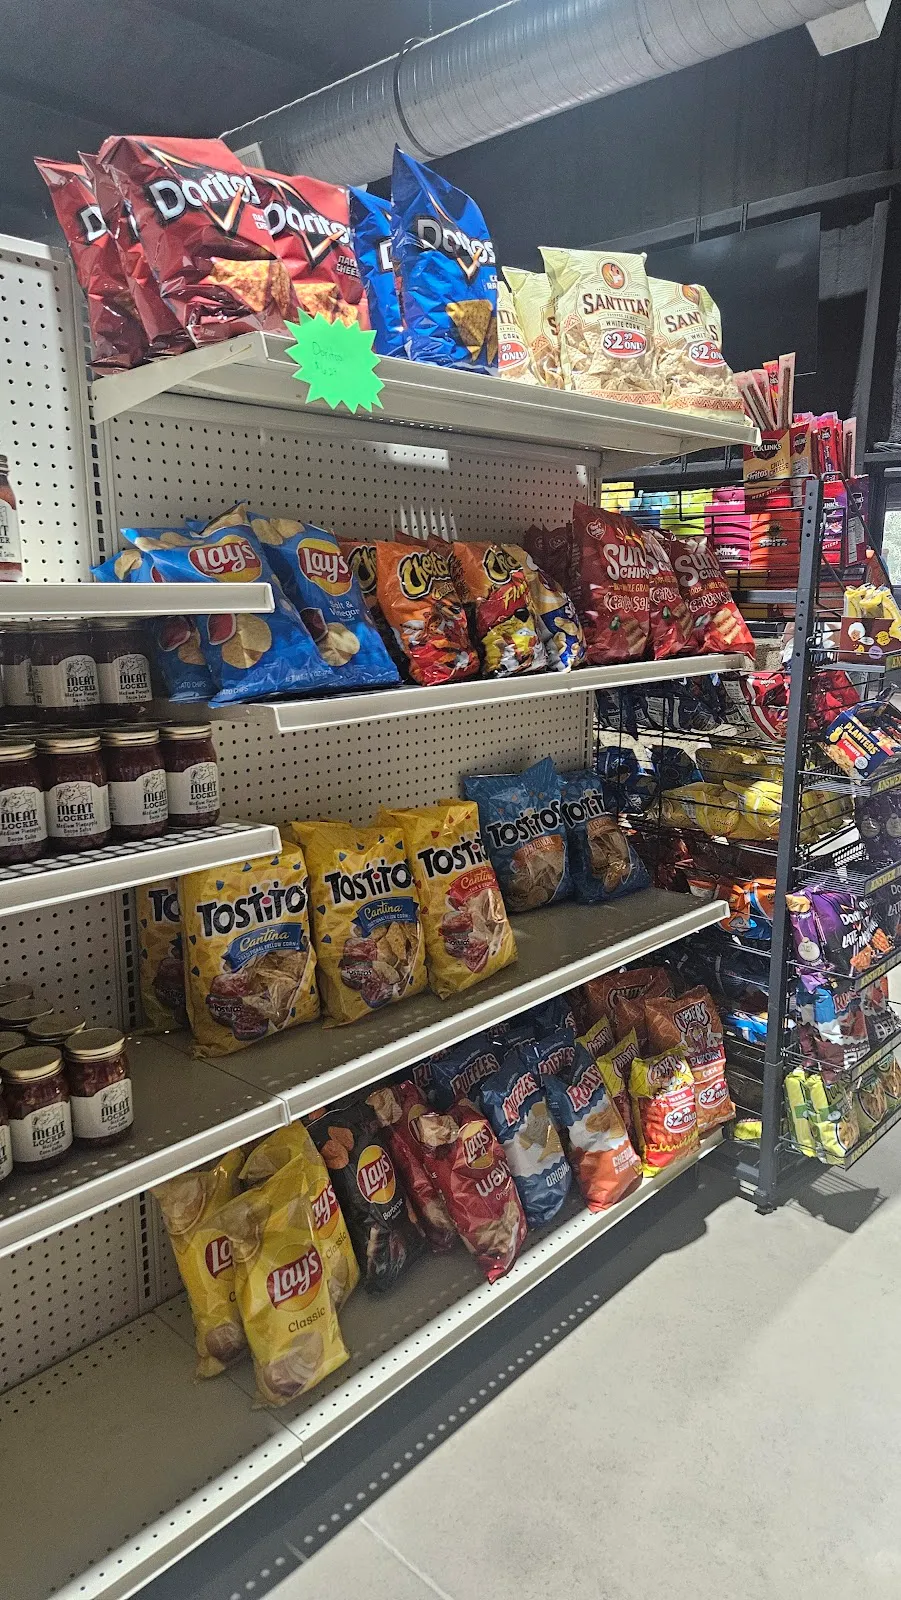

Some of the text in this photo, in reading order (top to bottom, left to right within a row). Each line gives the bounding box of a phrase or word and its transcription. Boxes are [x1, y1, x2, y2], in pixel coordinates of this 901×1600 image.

[606, 321, 640, 331] WHITE CORN
[603, 334, 623, 350] $2
[747, 470, 768, 480] Fritos
[195, 540, 256, 573] Lay's
[302, 547, 349, 583] Lay's
[619, 565, 650, 579] CHIPS
[329, 607, 360, 621] Vinegar
[67, 675, 95, 686] MEAT
[120, 672, 147, 684] MEAT
[843, 721, 879, 755] PLANTERS
[144, 789, 167, 803] MEAT
[191, 780, 217, 794] MEAT
[1, 809, 37, 823] MEAT
[57, 802, 93, 816] MEAT
[57, 813, 95, 823] LOCKER
[2, 819, 39, 831] LOCKER
[486, 799, 564, 848] TOSTITOS
[364, 900, 403, 920] Cantina
[239, 927, 290, 952] Cantina
[101, 1097, 130, 1117] MEAT
[33, 1120, 65, 1141] MEAT
[33, 1130, 66, 1148] LOCKER
[464, 1128, 490, 1164] Lay's
[361, 1154, 391, 1197] Lay's
[326, 1231, 347, 1259] Classic
[274, 1249, 319, 1303] Lay's
[288, 1305, 326, 1333] Classic
